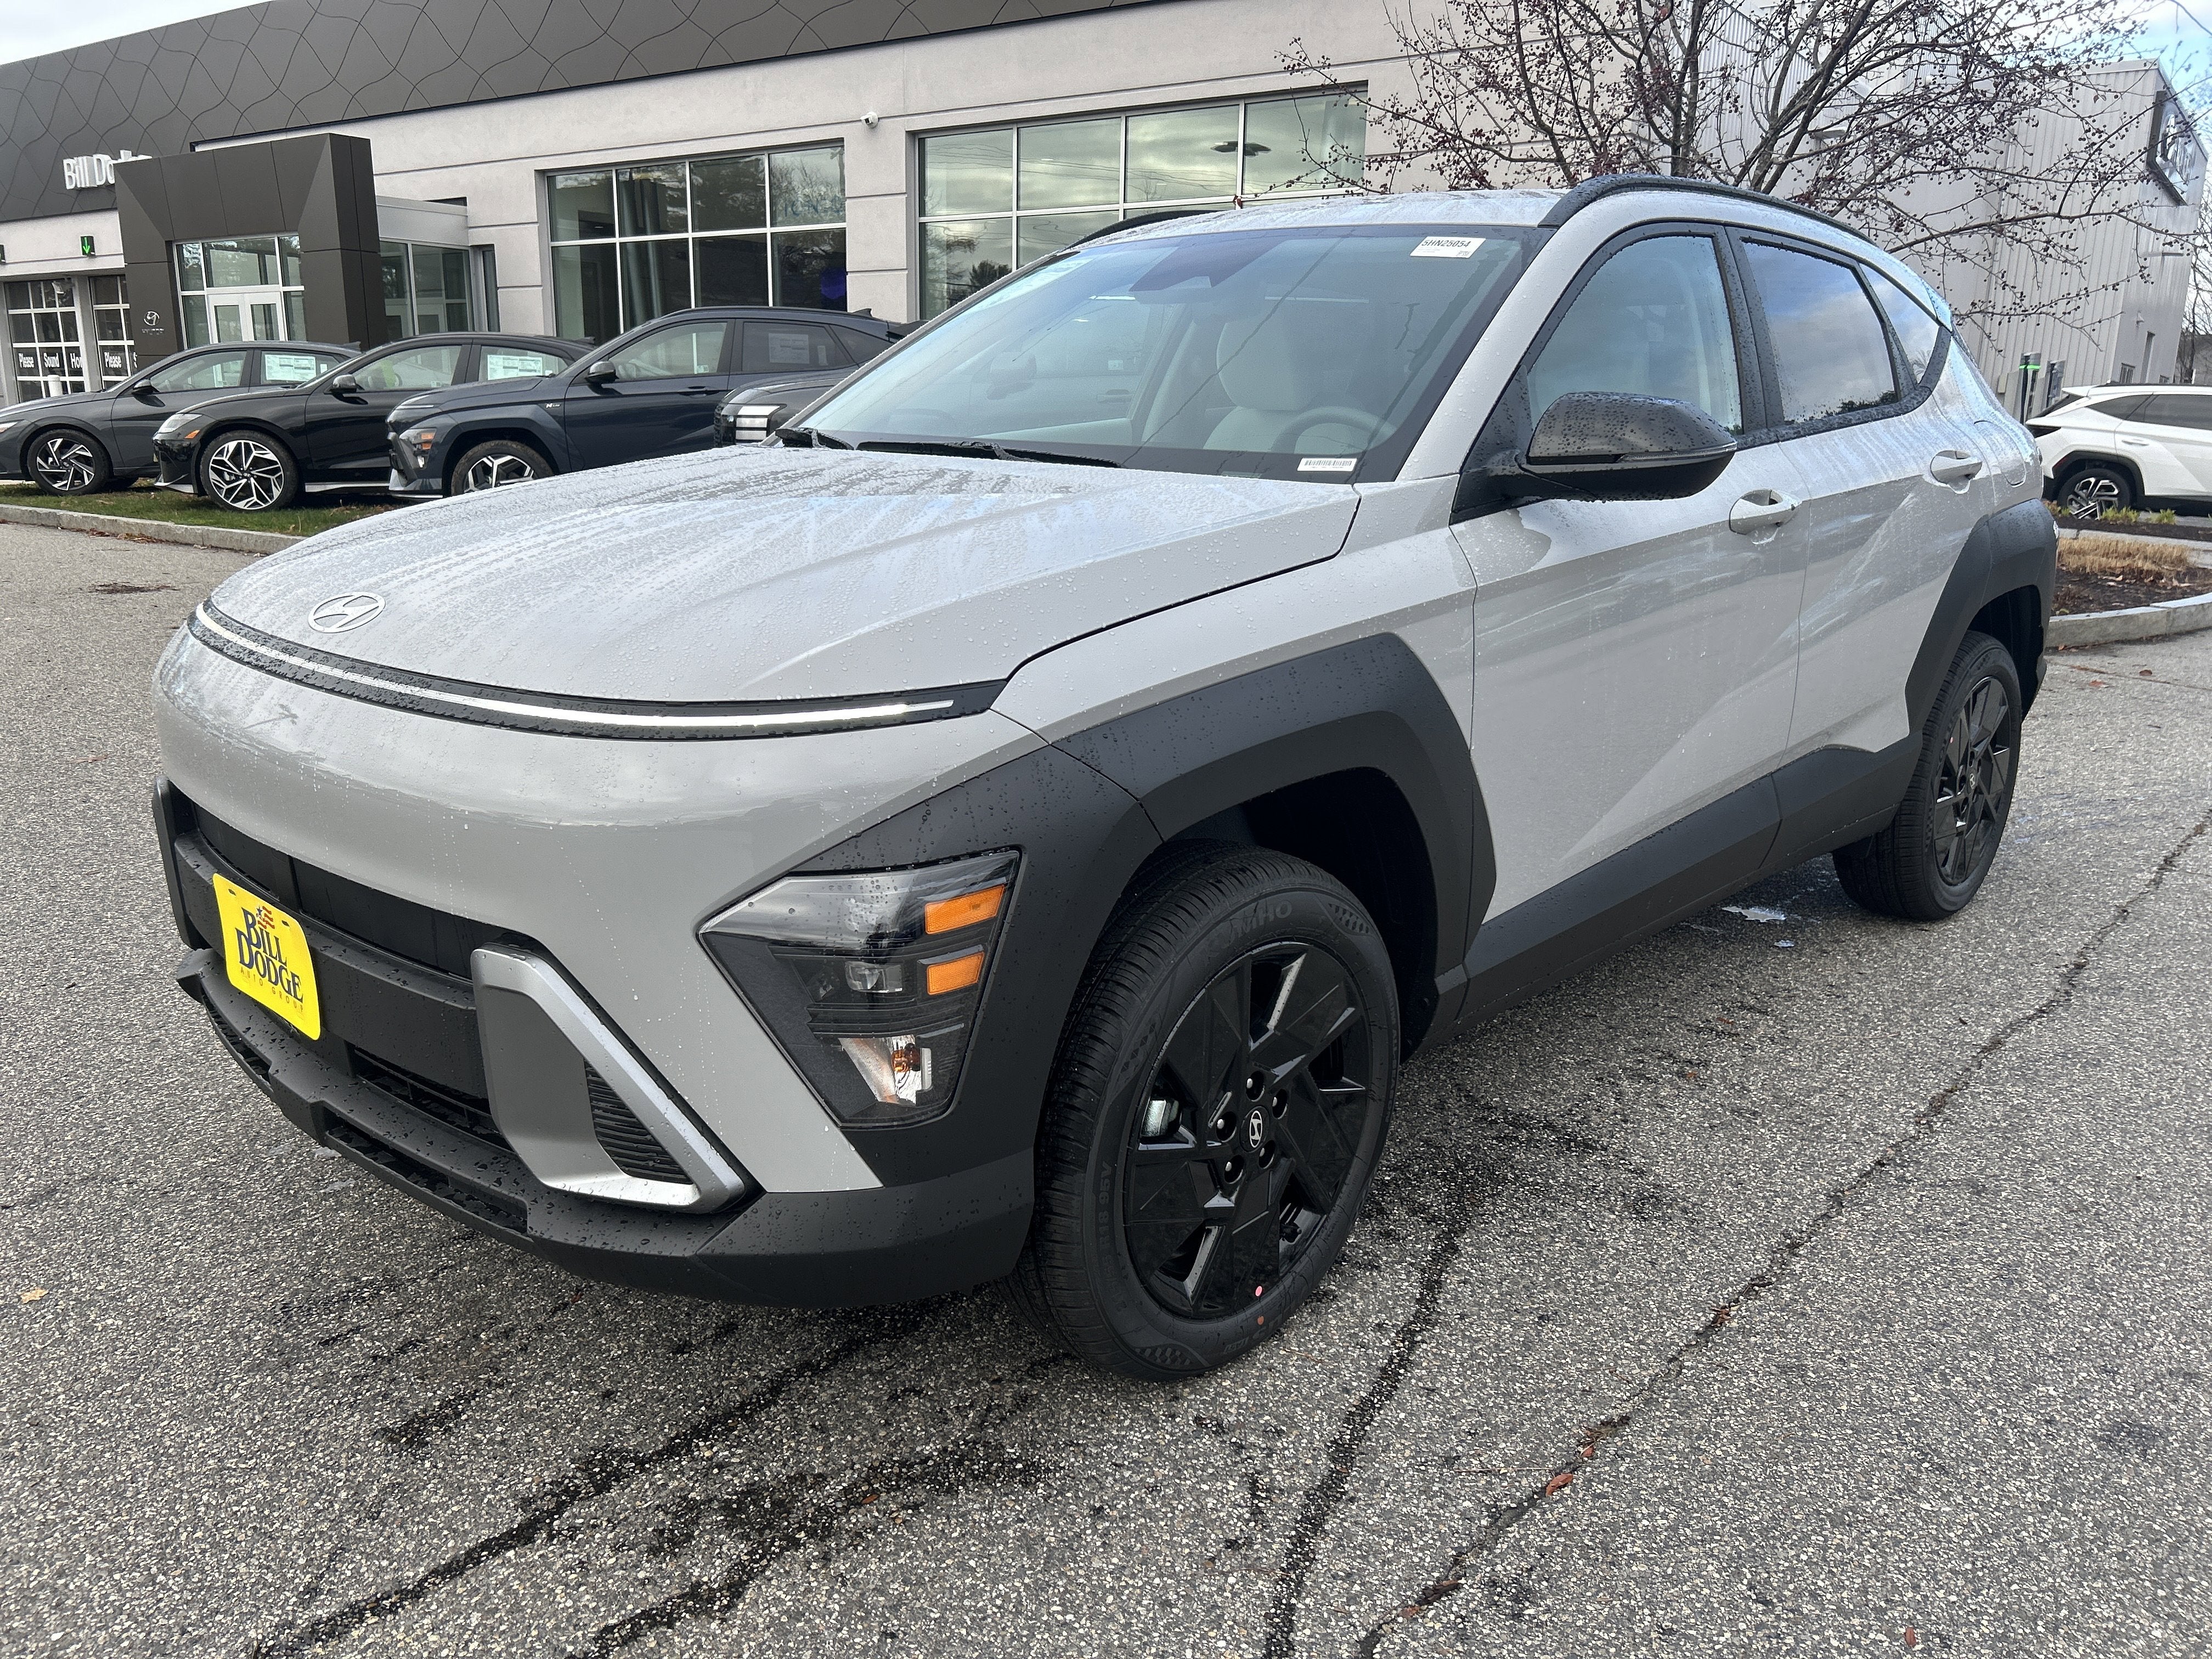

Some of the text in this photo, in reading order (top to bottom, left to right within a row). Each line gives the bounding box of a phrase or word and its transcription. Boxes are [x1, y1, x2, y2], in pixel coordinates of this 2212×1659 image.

[63, 156, 97, 189] Bill
[19, 353, 35, 368] Please
[44, 352, 60, 368] Sound
[104, 352, 122, 368] Please
[241, 907, 287, 967] BILL
[235, 927, 303, 1003] DODGE
[240, 967, 303, 1013] AUTO GROUP
[1098, 1160, 1112, 1204] 95V
[1098, 1210, 1110, 1249] R18
